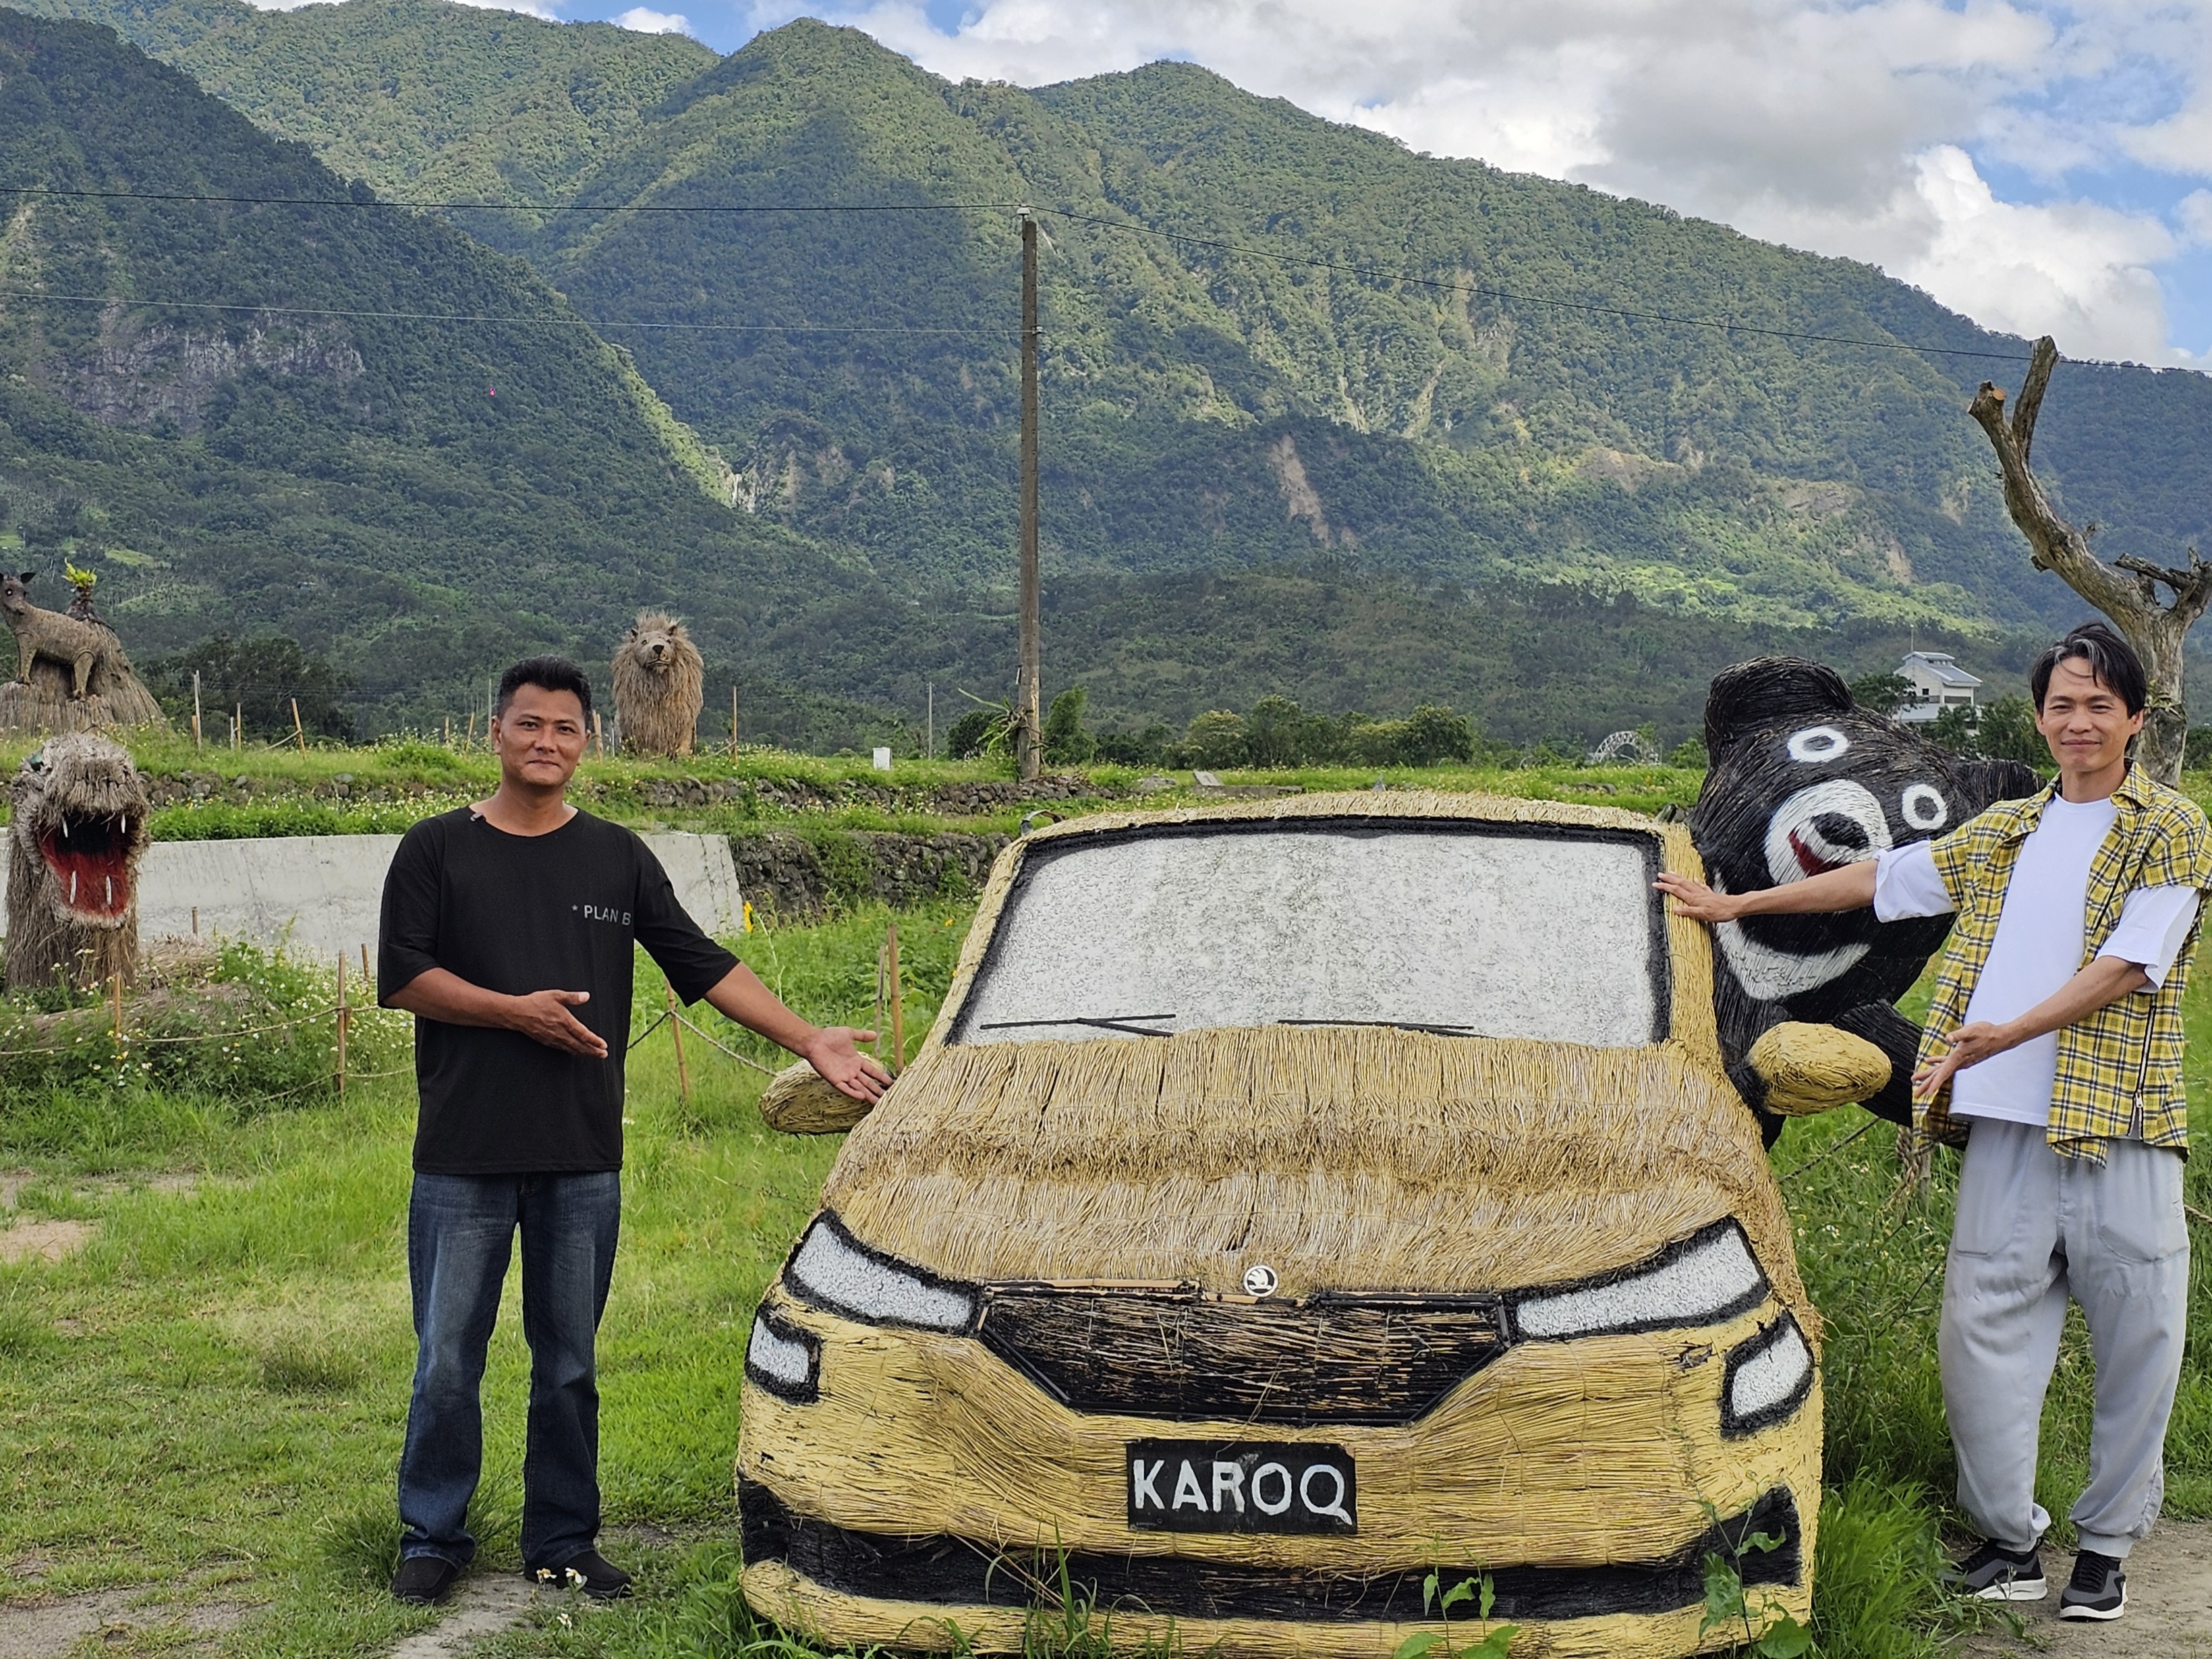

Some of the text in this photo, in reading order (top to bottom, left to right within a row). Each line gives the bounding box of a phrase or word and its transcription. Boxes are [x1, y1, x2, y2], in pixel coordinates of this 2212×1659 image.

[584, 905, 631, 926] PLAN B
[1133, 1459, 1353, 1525] KAROQ
